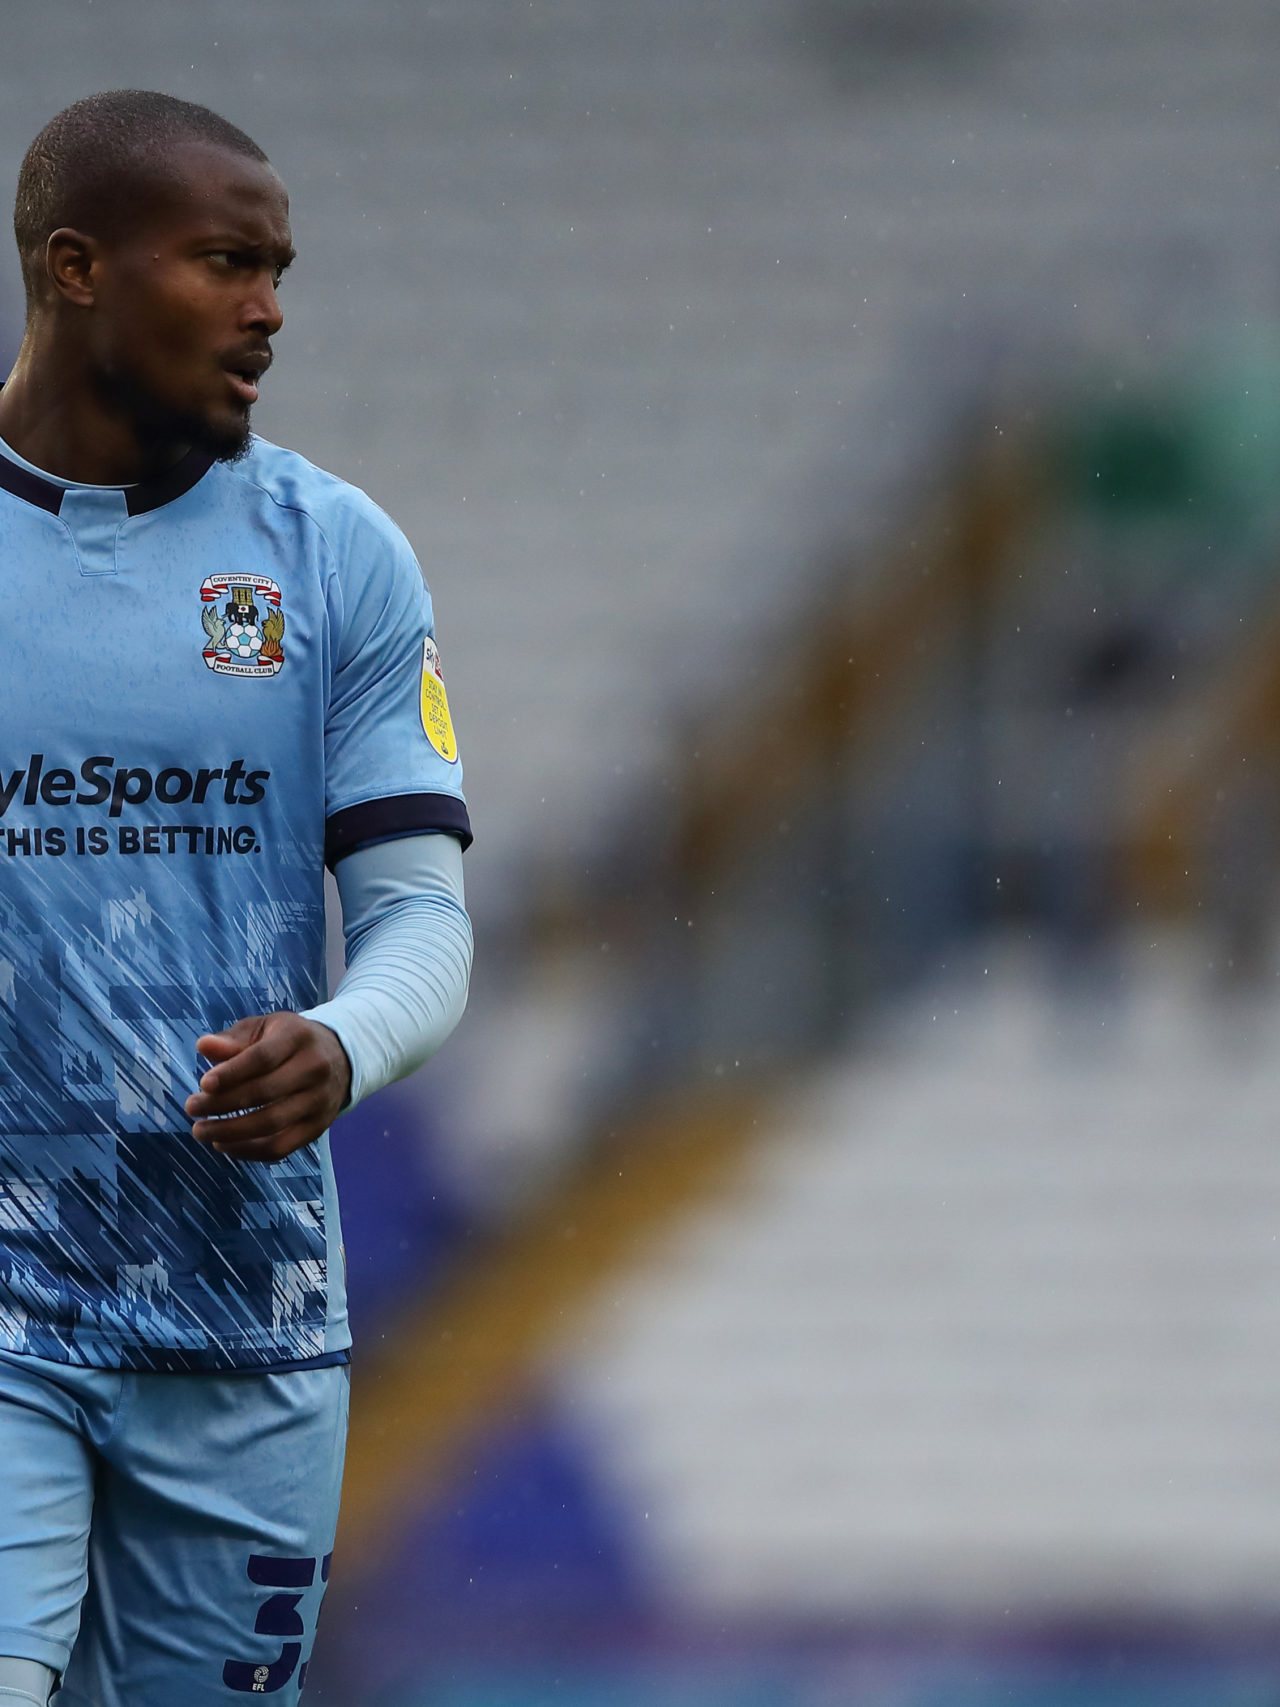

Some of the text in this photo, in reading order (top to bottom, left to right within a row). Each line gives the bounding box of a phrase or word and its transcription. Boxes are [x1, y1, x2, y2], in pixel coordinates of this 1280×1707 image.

[253, 577, 270, 585] CITY
[216, 664, 253, 674] FOOTBALL
[76, 826, 109, 855] IS
[120, 825, 262, 855] BETTING.
[252, 1683, 265, 1692] EFL
